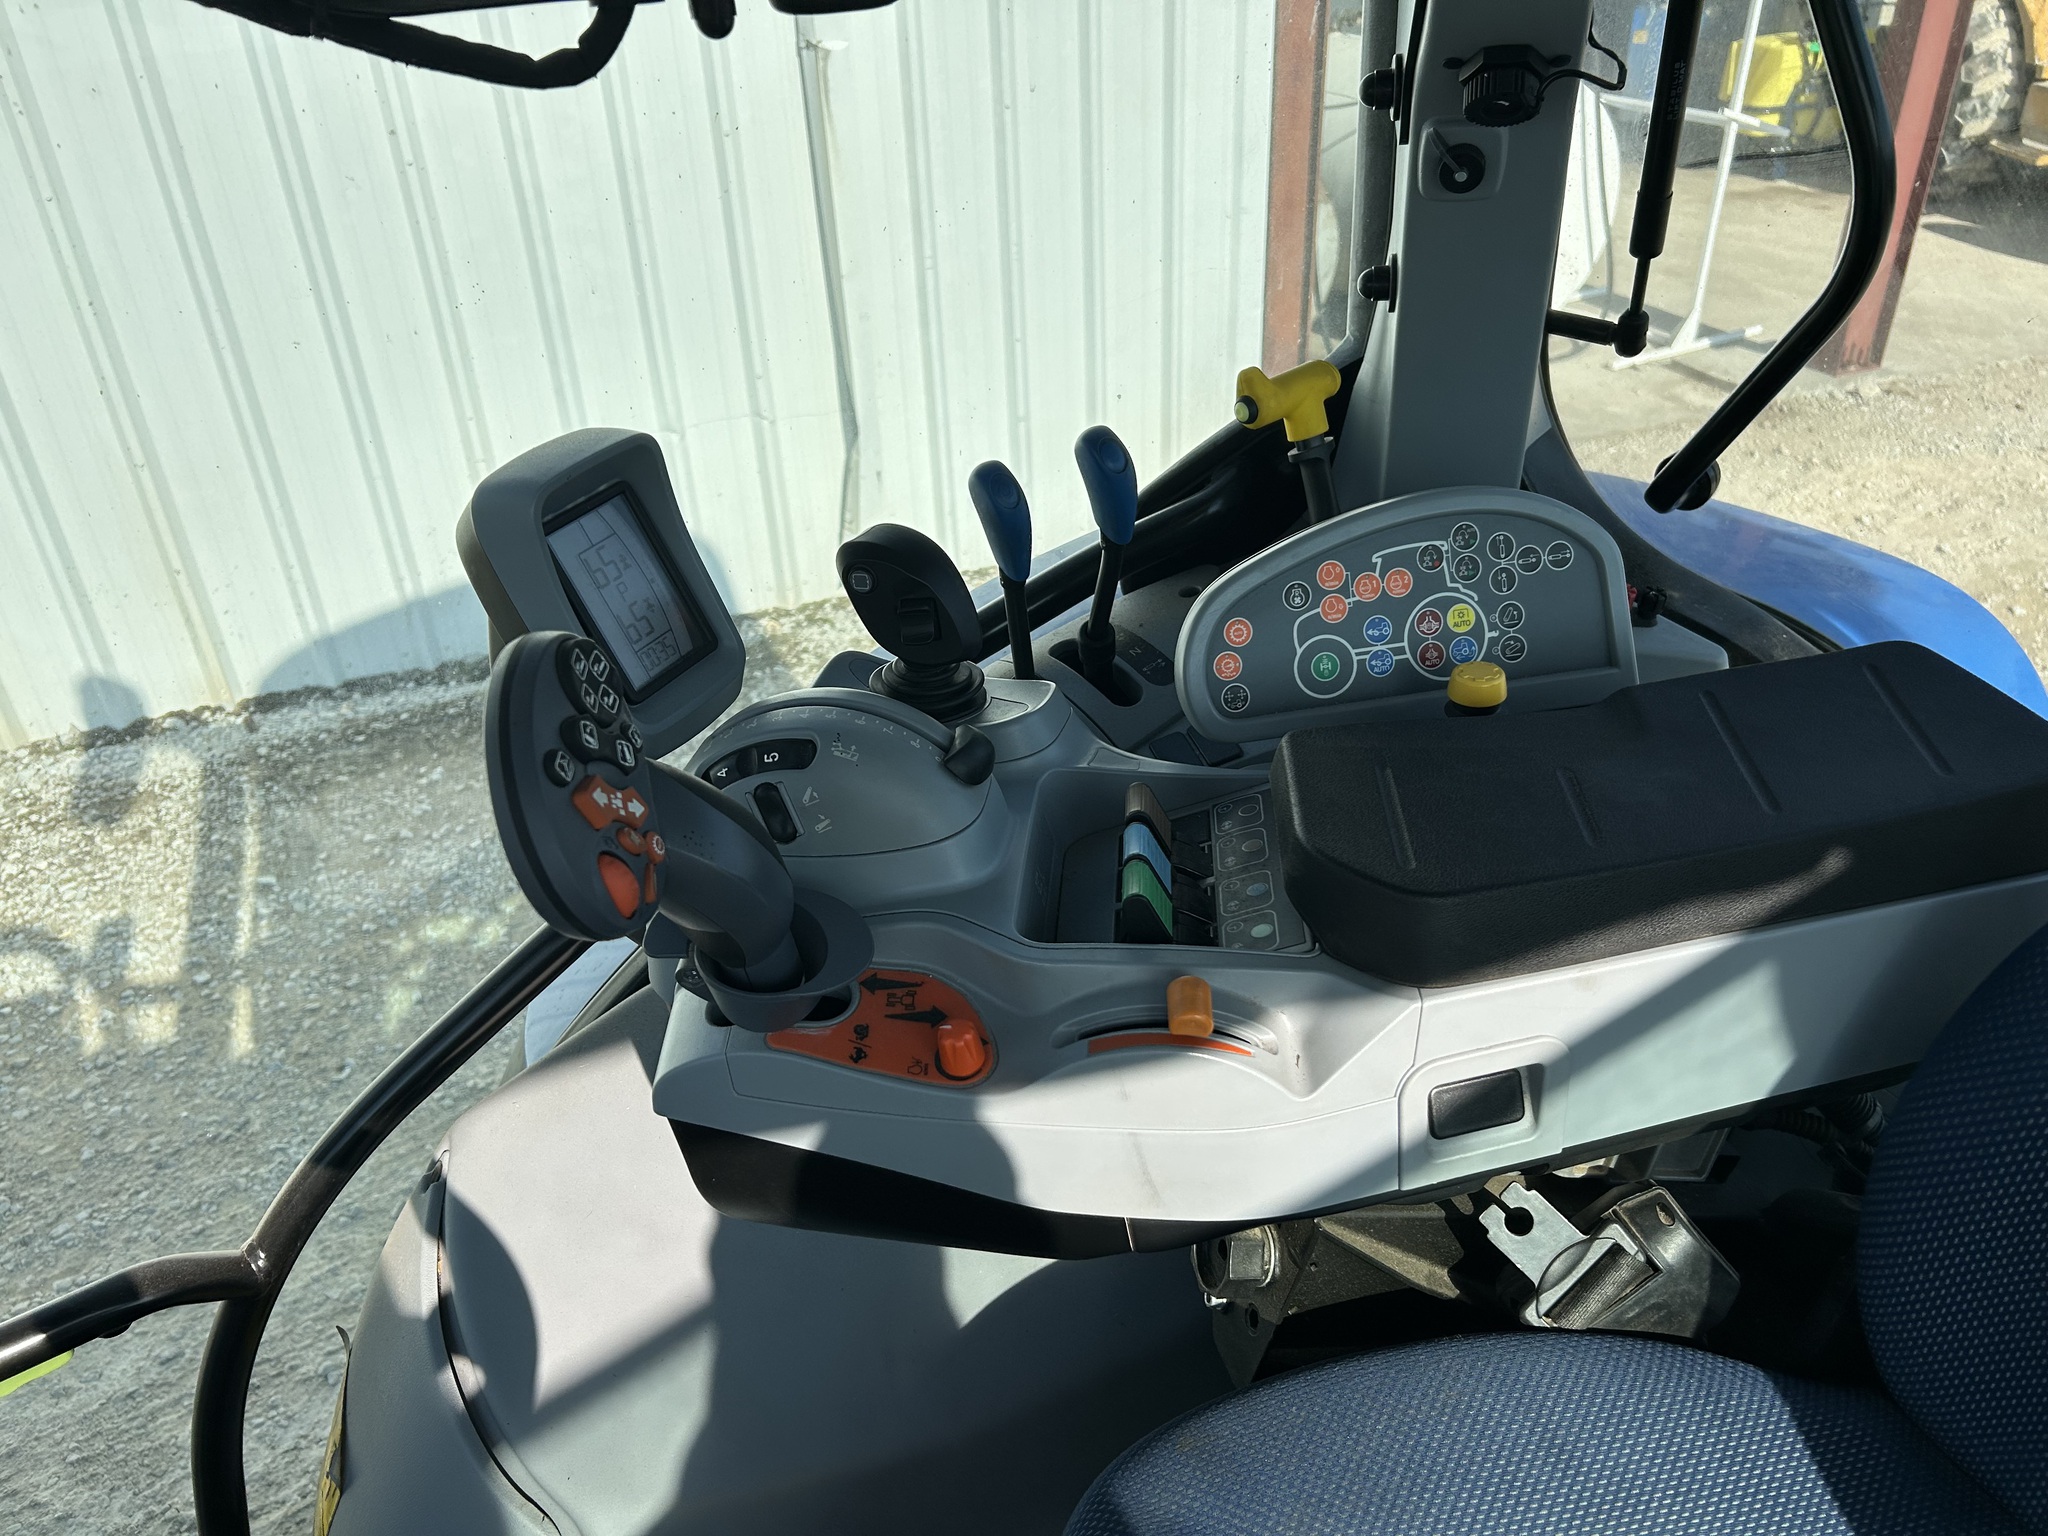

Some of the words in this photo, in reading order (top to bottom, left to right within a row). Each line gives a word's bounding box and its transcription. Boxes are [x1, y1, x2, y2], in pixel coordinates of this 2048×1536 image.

[1372, 580, 1377, 588] 1
[1403, 576, 1409, 584] 2
[1452, 619, 1472, 628] AUTO
[1424, 658, 1440, 666] AUTO
[1373, 665, 1390, 674] AUTO
[764, 752, 779, 763] 5
[717, 767, 728, 777] 4
